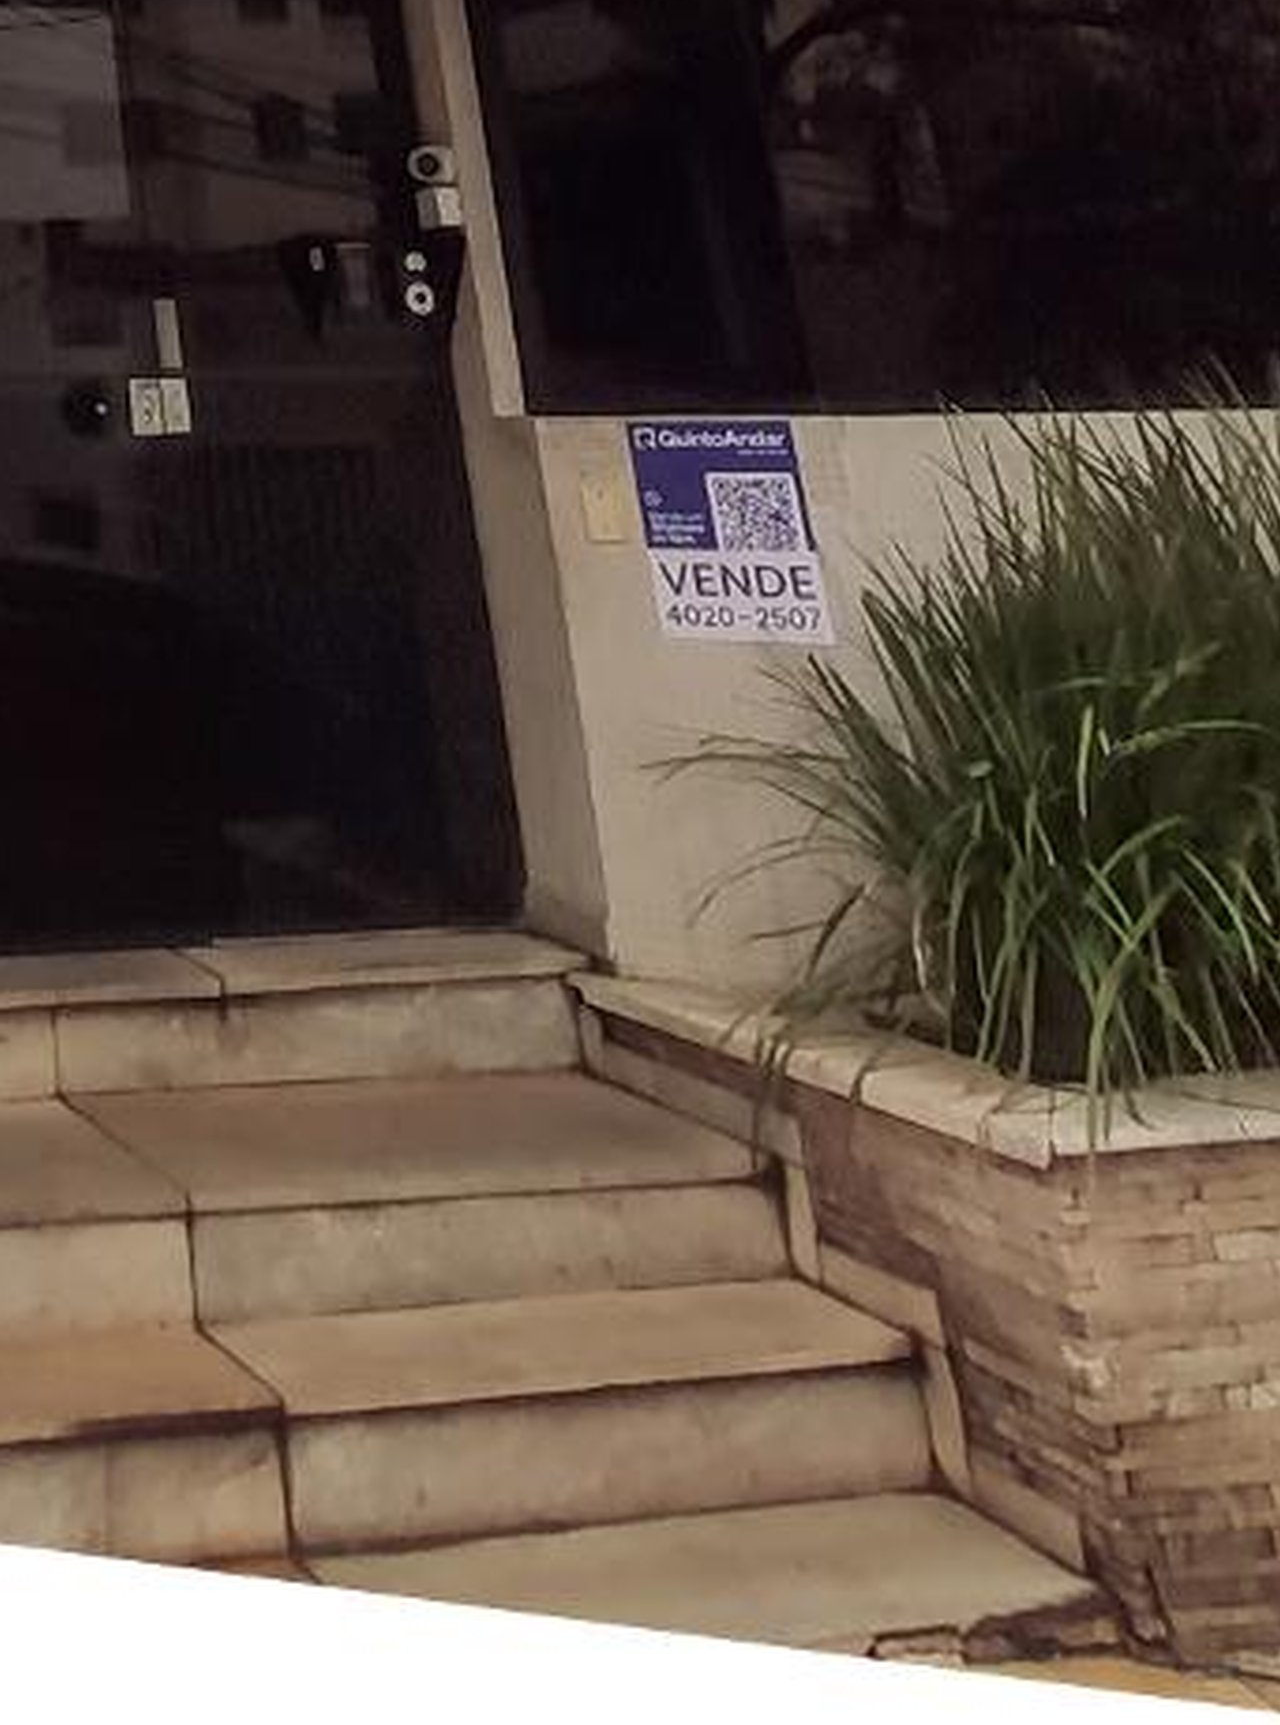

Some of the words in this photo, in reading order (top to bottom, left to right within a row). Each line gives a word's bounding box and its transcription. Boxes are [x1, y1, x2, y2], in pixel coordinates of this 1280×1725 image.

[657, 429, 787, 447] QuintoAndar
[658, 562, 818, 600] VENDE
[666, 604, 821, 631] 4020-2507
